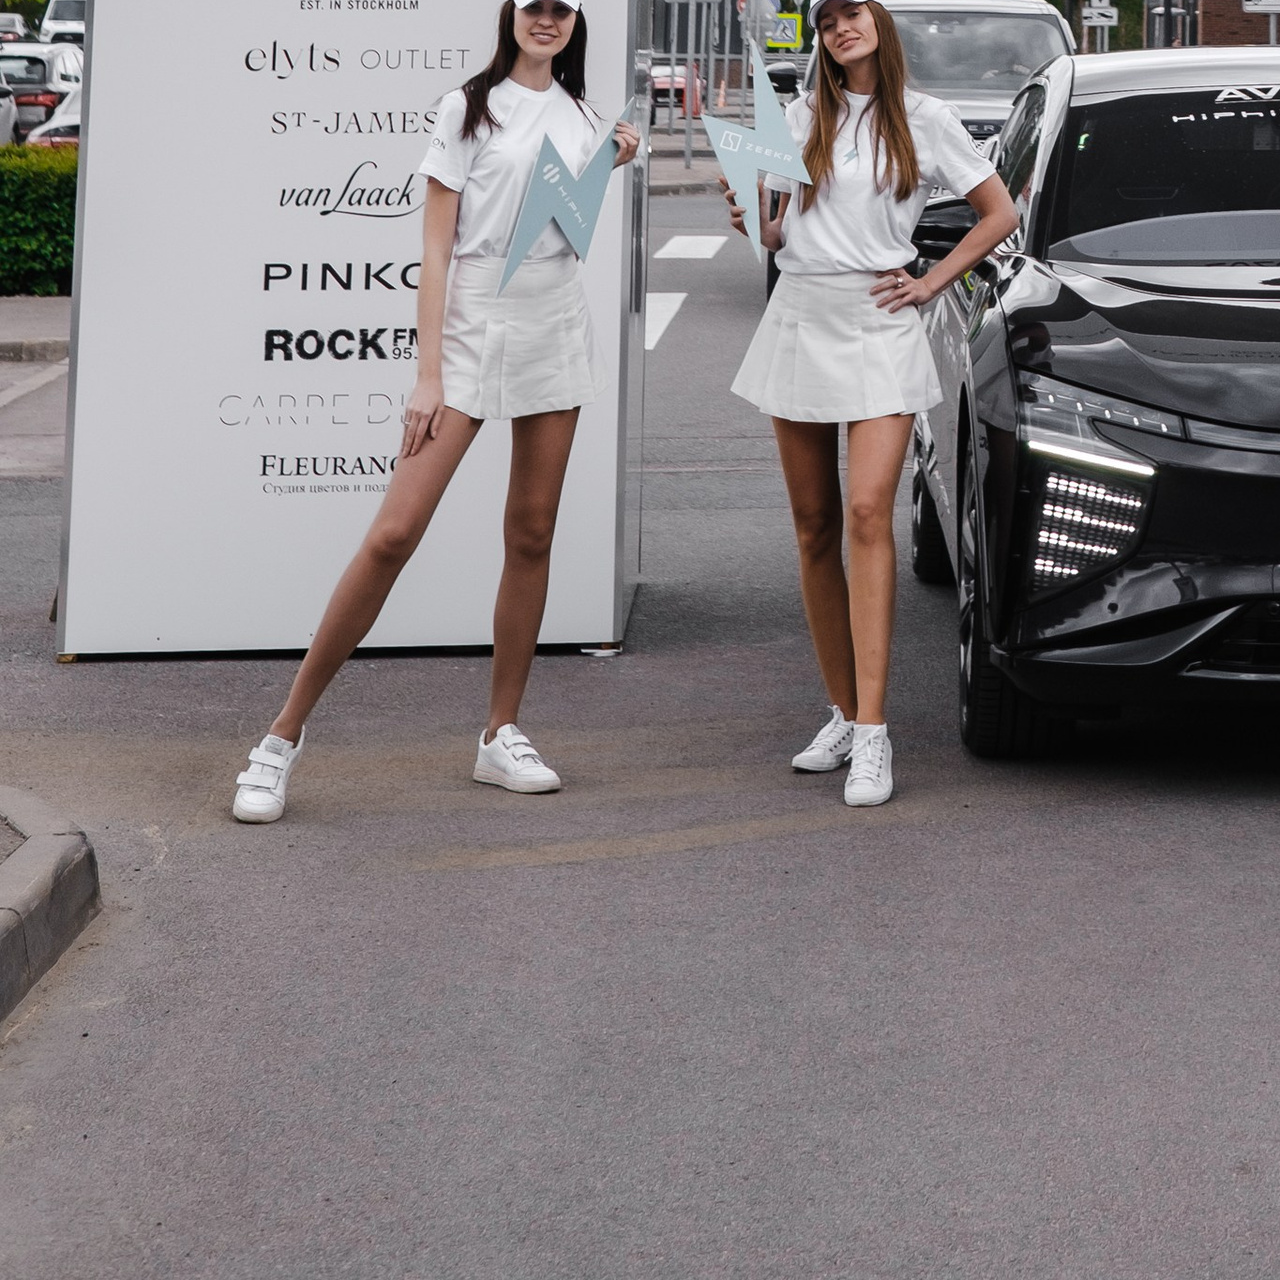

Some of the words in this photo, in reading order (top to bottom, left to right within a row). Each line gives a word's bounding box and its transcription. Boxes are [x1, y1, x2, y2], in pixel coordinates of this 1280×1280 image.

[300, 0, 324, 10] EST.
[329, 0, 342, 10] IN
[347, 0, 419, 11] STOCKHOLM
[360, 48, 471, 70] OUTLET
[745, 142, 793, 162] ZEEKR
[264, 328, 389, 361] ROCK
[218, 394, 350, 426] CARPE
[262, 483, 306, 496] Студия
